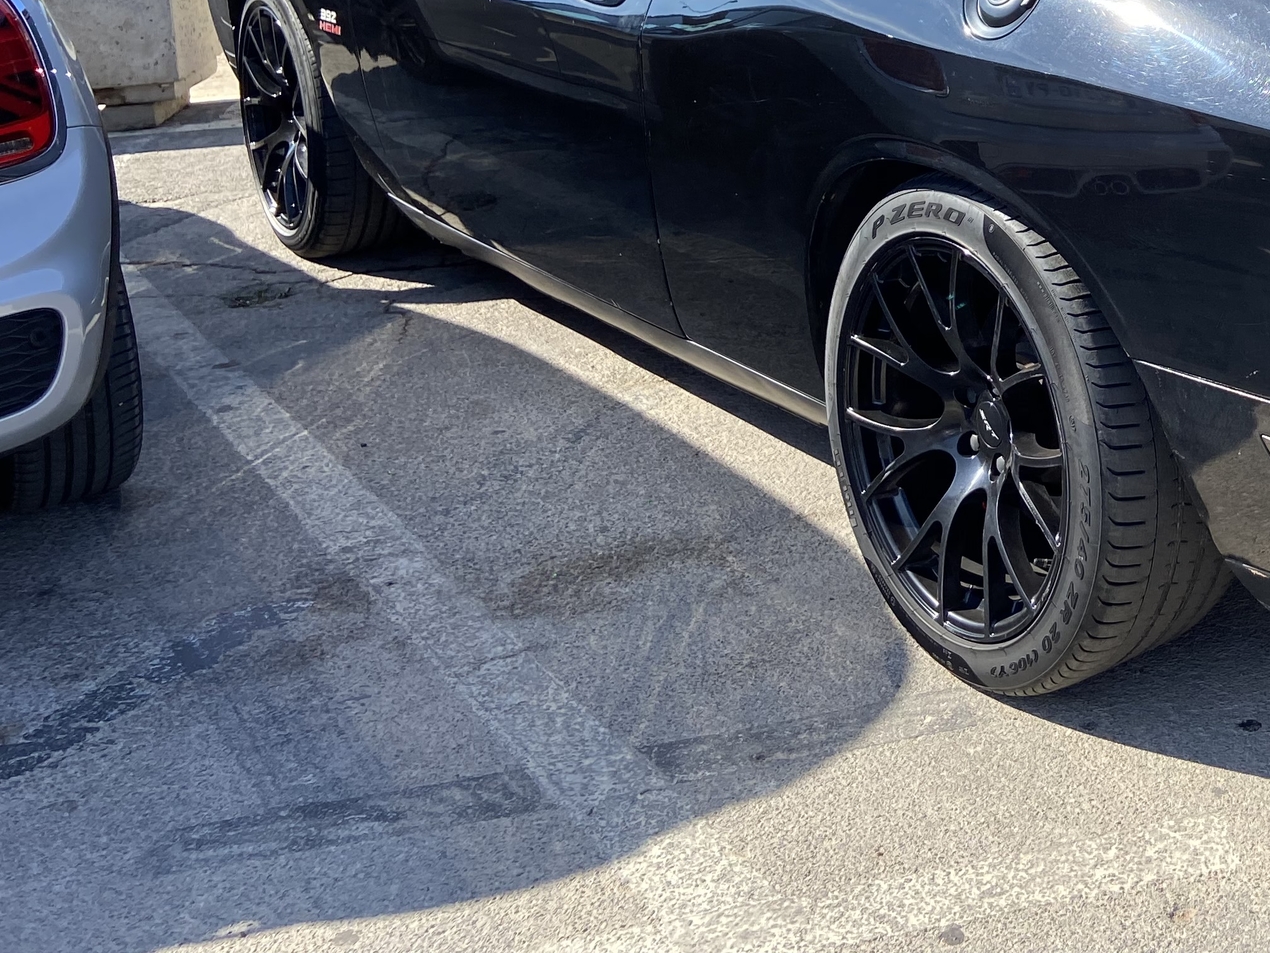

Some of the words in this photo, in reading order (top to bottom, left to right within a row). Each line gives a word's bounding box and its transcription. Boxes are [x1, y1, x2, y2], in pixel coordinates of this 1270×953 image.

[319, 21, 342, 36] HEMI
[871, 214, 885, 239] P
[890, 201, 966, 227] ZERO
[979, 408, 1000, 440] SRT
[1073, 458, 1092, 580] 275/40
[1042, 622, 1061, 654] 20
